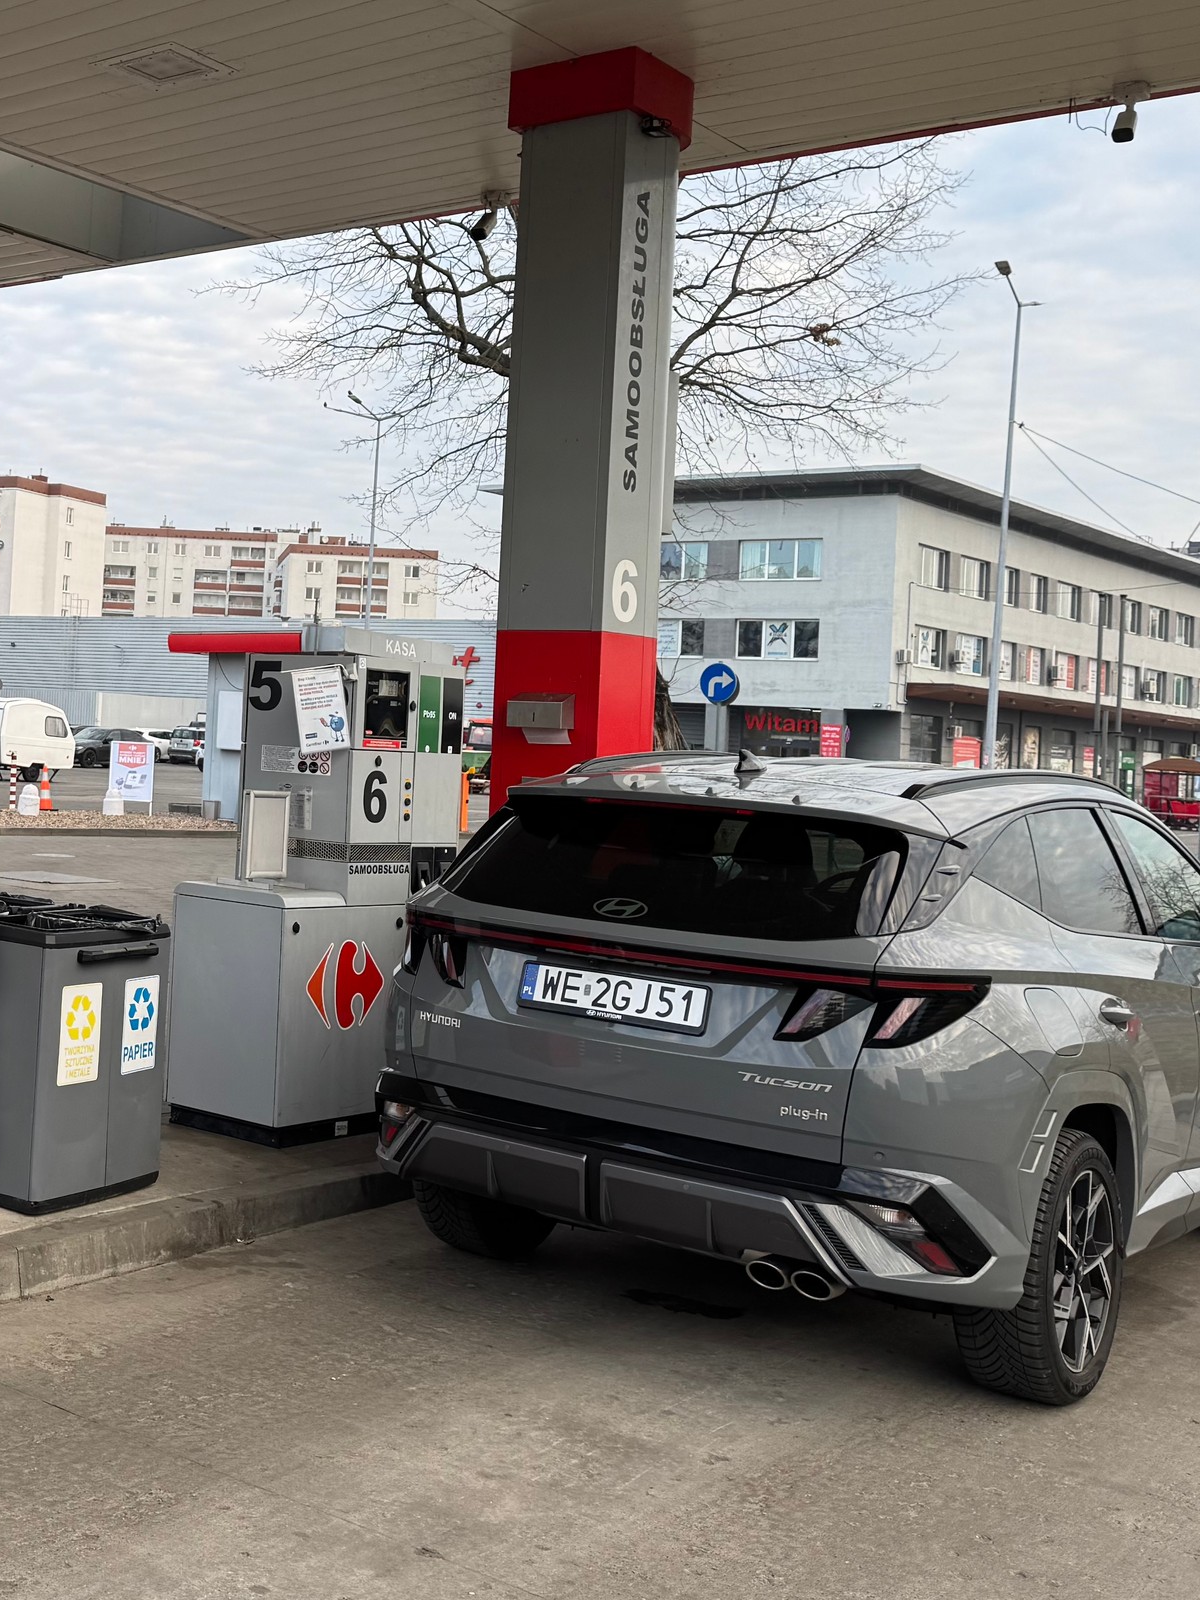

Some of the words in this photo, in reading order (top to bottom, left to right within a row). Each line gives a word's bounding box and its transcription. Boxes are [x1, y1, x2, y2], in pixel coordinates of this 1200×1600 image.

[622, 191, 651, 493] SAMOOBSŁUGA
[611, 559, 639, 623] 6
[385, 638, 417, 658] KASA
[248, 660, 283, 712] 5
[422, 709, 436, 719] Pb95
[448, 711, 457, 721] ON
[119, 756, 146, 764] MNIEJ
[362, 769, 388, 824] 6
[348, 863, 410, 876] SAMOOBSŁUGA
[522, 985, 533, 995] PL
[541, 969, 583, 1004] WE
[591, 977, 694, 1022] 2GJ51
[420, 1010, 461, 1029] HYUNDAI
[596, 1012, 623, 1020] HYUNDAI
[122, 1041, 154, 1062] PAPIER
[779, 1105, 828, 1121] plug-in
